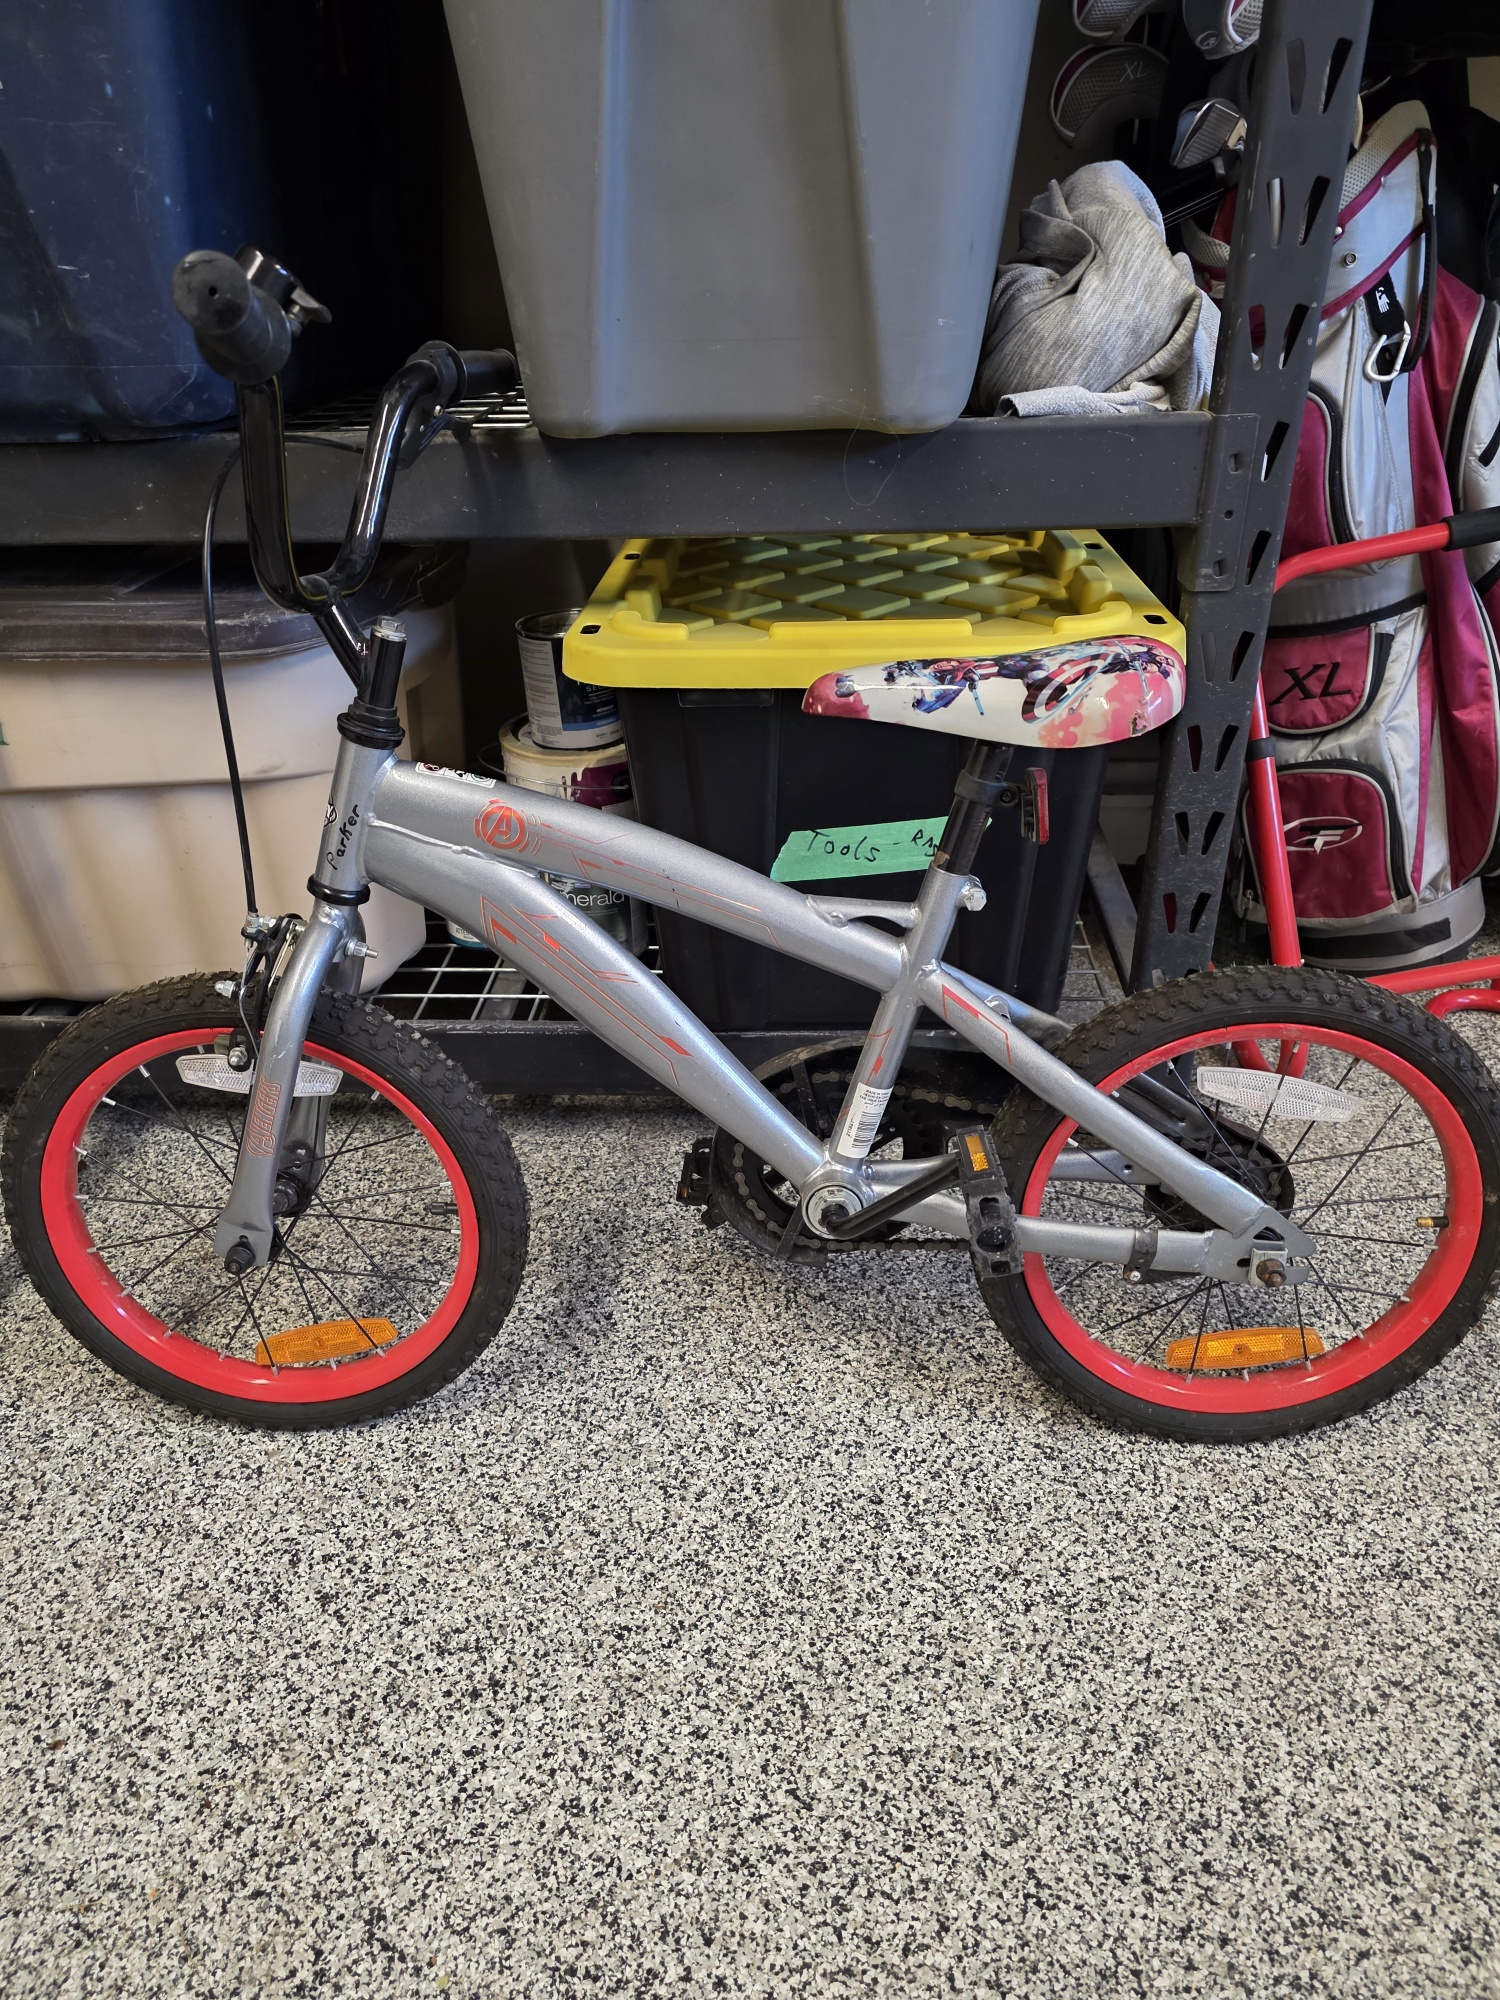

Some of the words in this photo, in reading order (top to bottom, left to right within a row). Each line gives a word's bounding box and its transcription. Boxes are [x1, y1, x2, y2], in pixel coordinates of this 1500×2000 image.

[1119, 61, 1148, 82] XL
[1269, 661, 1354, 706] XL
[325, 804, 360, 871] Parker
[805, 829, 880, 863] Tools
